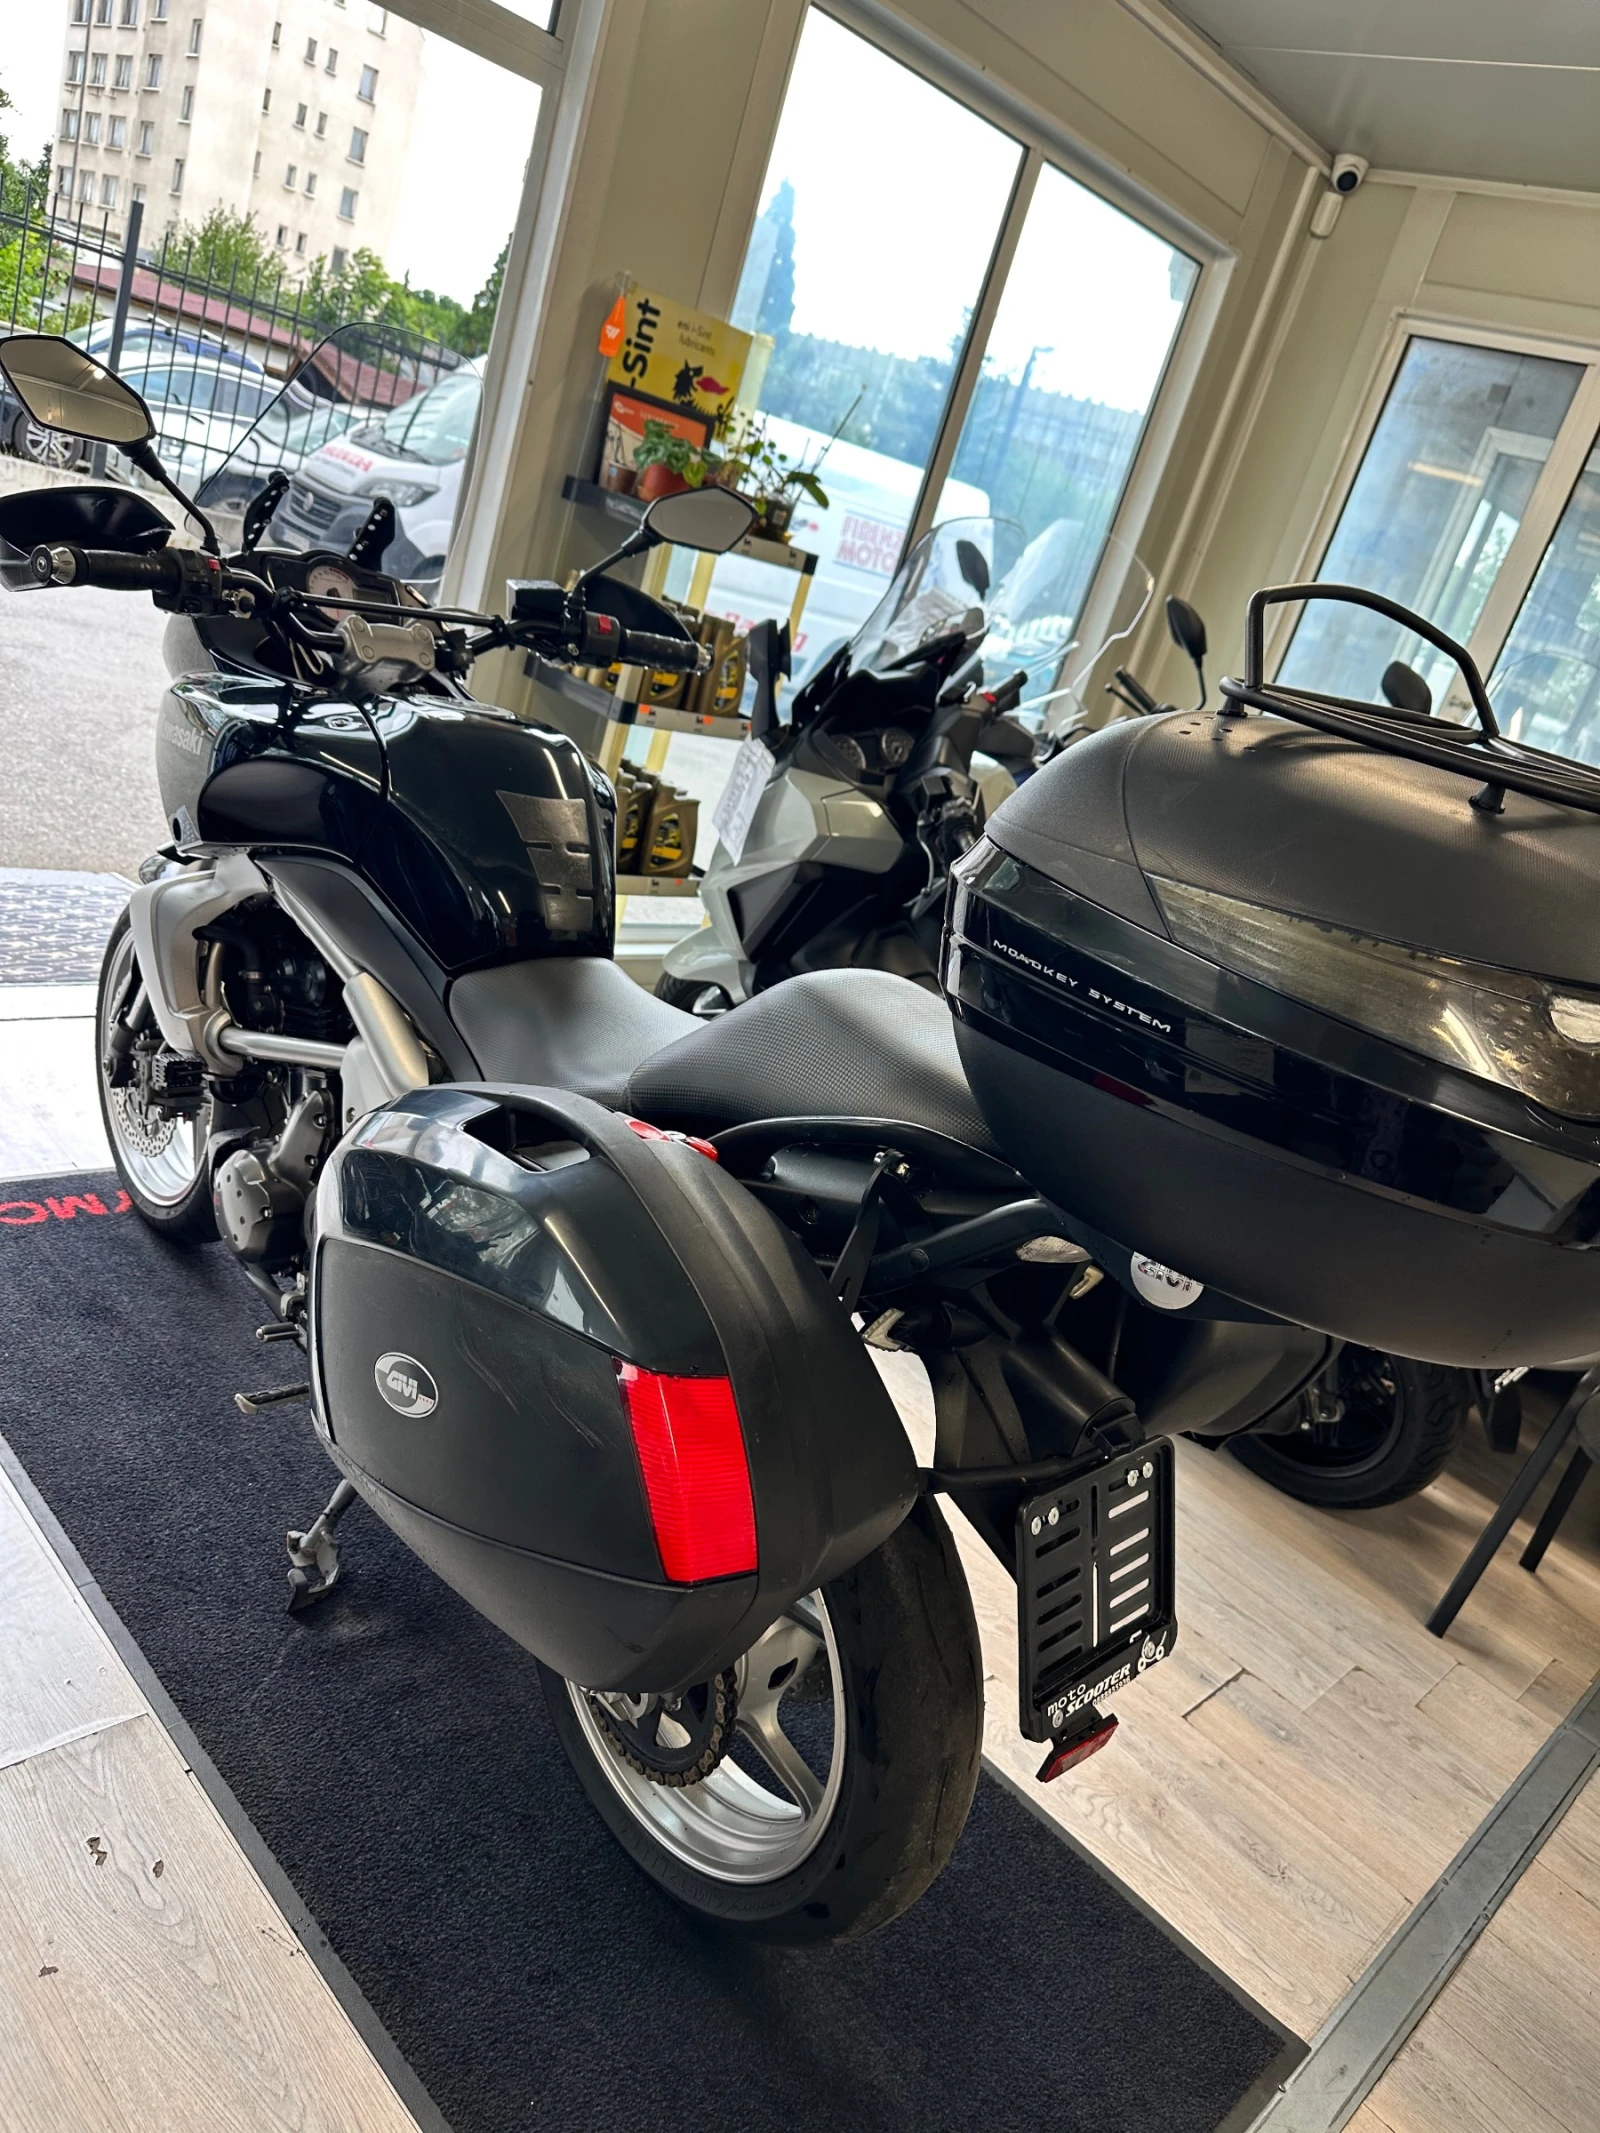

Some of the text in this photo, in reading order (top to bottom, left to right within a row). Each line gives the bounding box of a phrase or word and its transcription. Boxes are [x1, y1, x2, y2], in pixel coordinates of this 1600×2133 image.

[622, 297, 662, 389] -Sint
[160, 714, 206, 756] wasaki
[1087, 987, 1172, 1034] SYSTEM
[386, 1370, 419, 1401] GIVI
[1047, 1683, 1086, 1717] moto
[1065, 1663, 1131, 1717] SCOOTER
